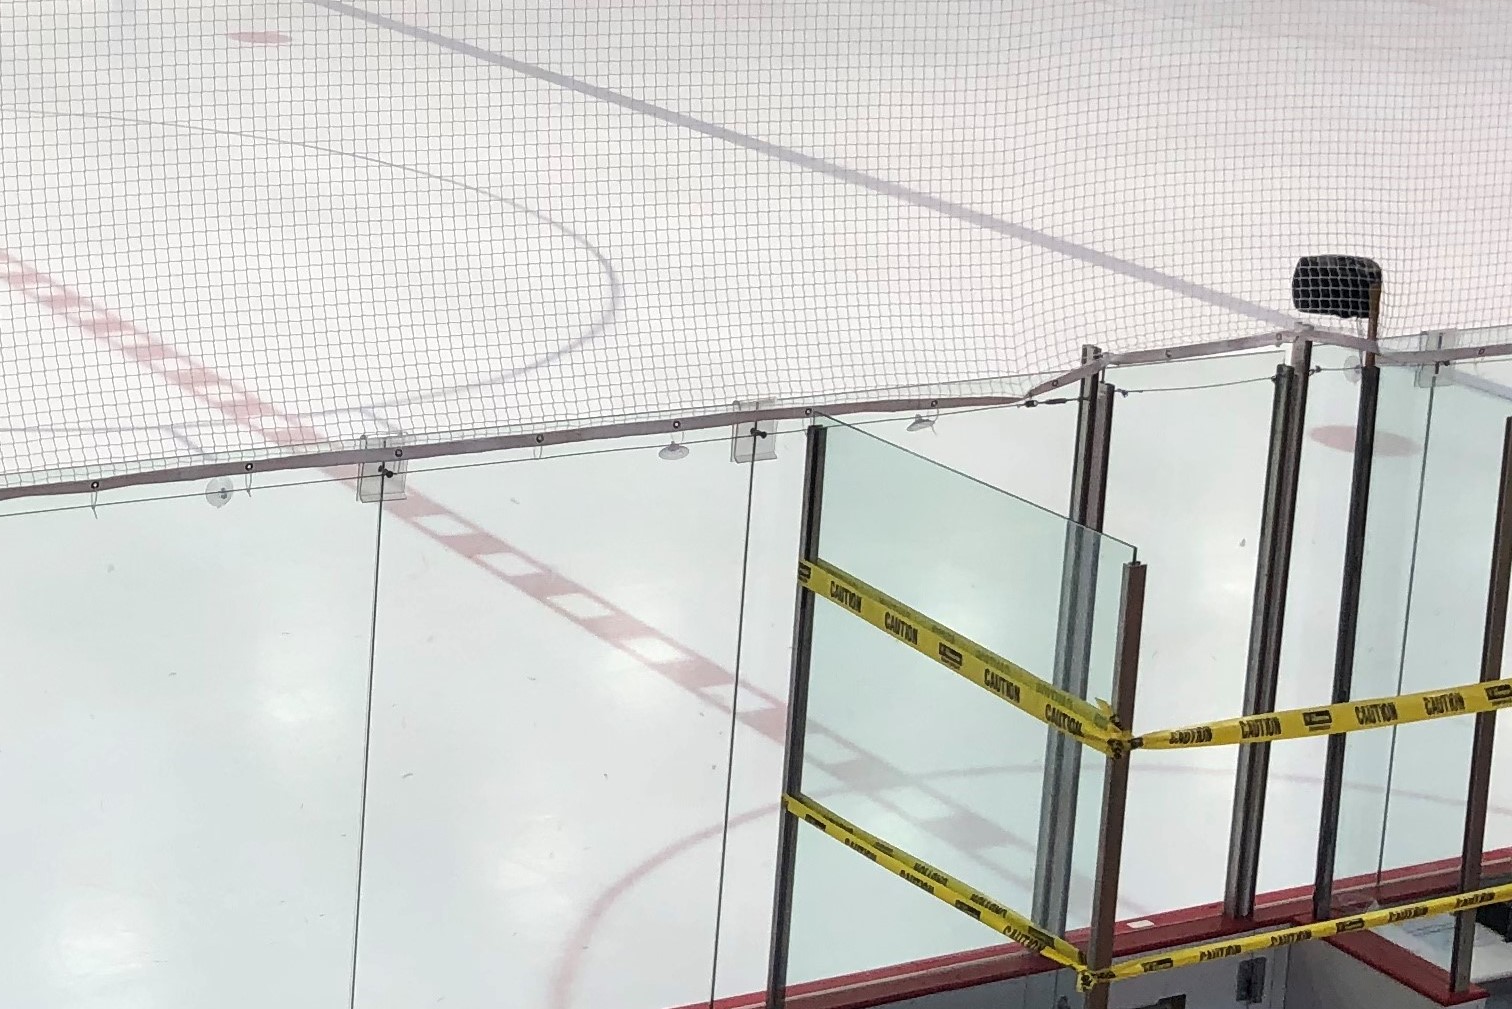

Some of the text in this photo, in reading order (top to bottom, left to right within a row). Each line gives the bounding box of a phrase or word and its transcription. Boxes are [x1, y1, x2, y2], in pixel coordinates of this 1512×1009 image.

[830, 580, 862, 614] CAUTION
[885, 612, 919, 646] CAUTION
[984, 668, 1021, 703] CAUTION
[1045, 703, 1082, 736] CAUTION
[1354, 701, 1398, 725] CAUTION
[1423, 692, 1465, 716] CAUTION
[1239, 716, 1281, 739] CAUTION
